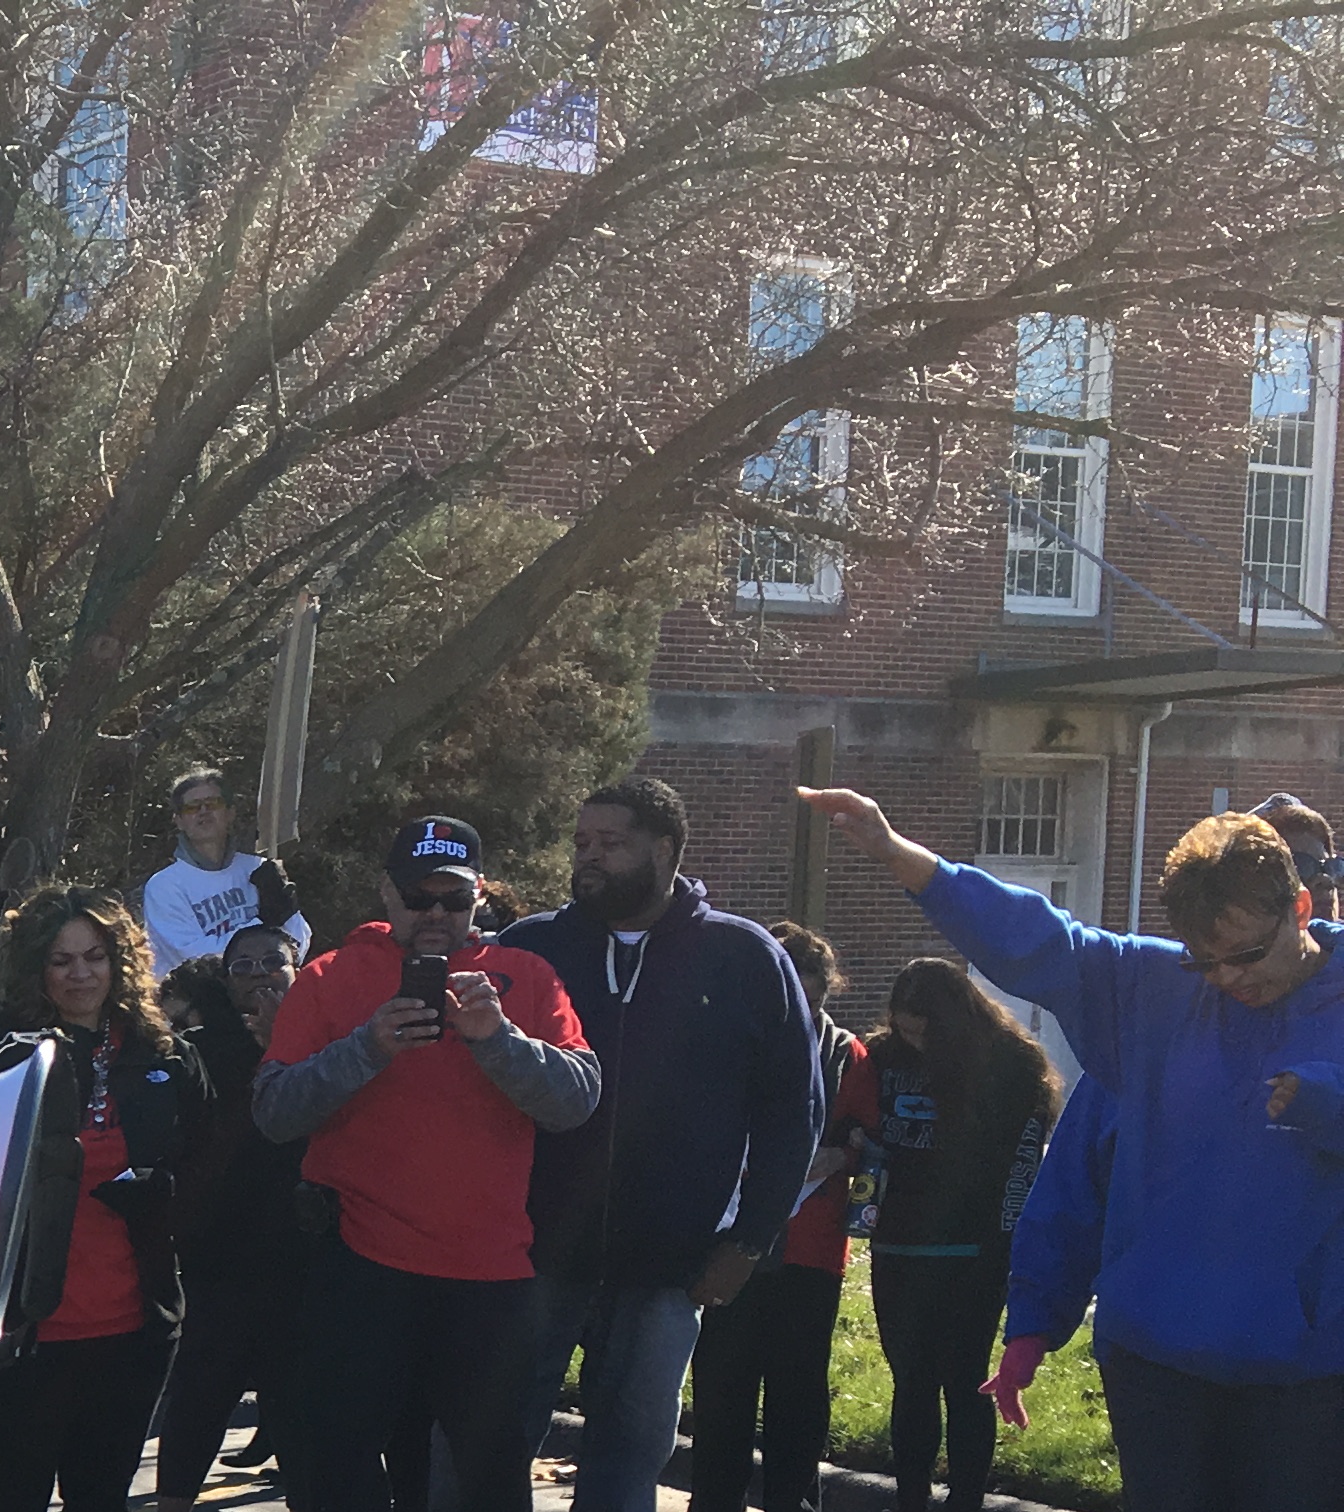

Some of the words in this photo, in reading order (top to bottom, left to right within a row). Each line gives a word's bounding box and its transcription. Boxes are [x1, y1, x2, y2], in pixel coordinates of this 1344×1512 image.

[424, 822, 436, 839] I
[412, 839, 467, 859] JESUS
[191, 887, 247, 930] STAND
